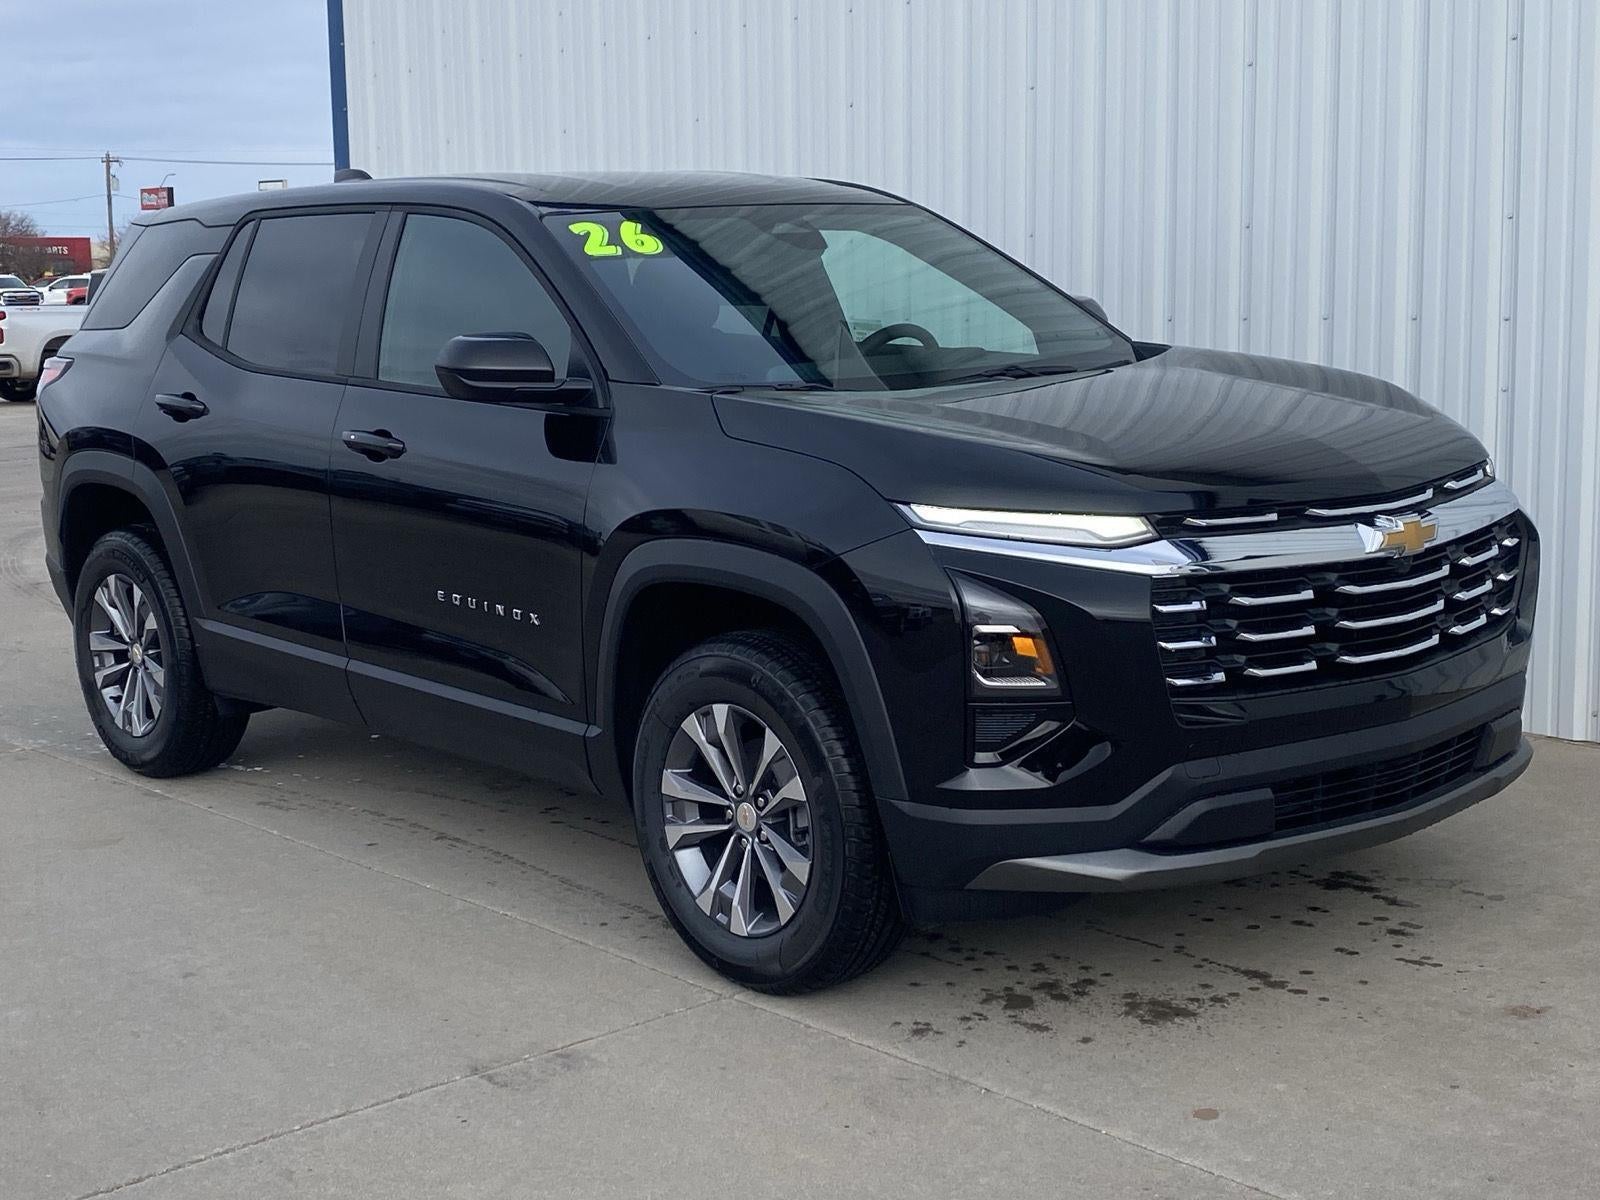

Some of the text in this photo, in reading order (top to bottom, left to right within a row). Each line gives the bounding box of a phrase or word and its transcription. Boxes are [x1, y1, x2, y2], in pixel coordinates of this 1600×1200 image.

[43, 246, 69, 255] ARTS
[568, 220, 664, 257] 26
[436, 590, 541, 626] EQUINOX
